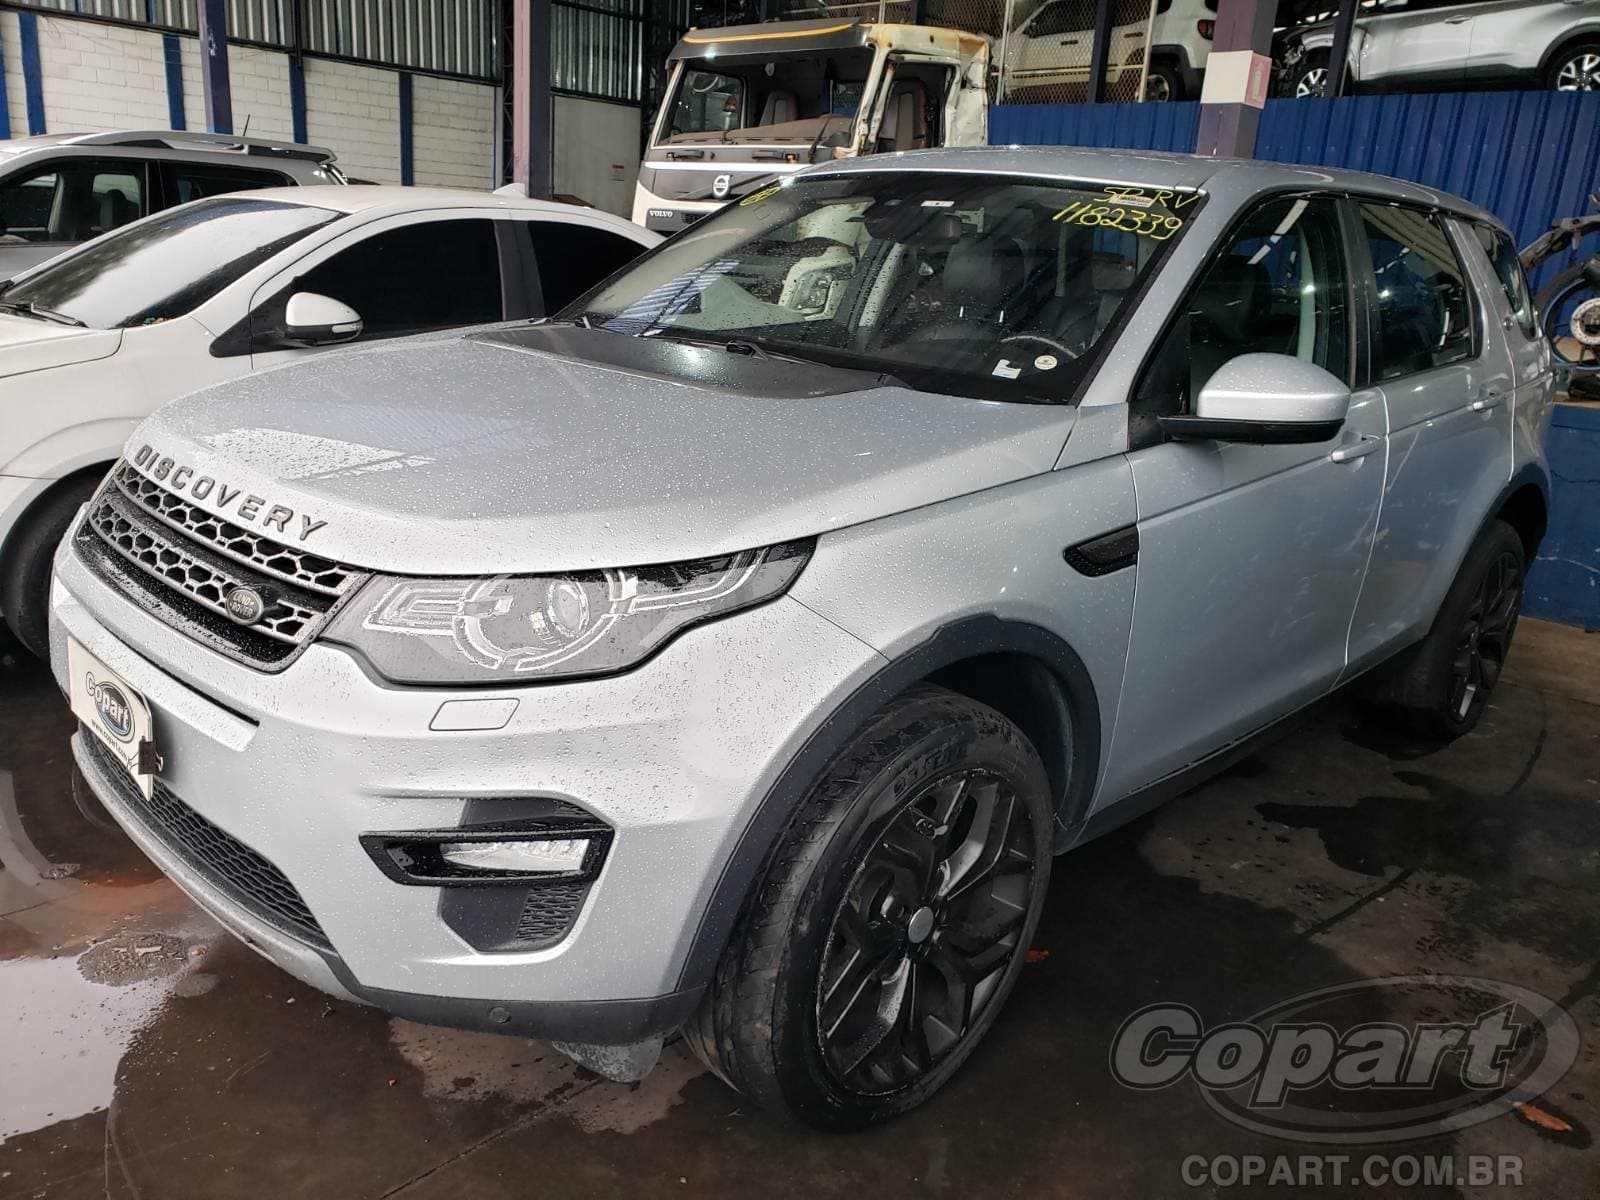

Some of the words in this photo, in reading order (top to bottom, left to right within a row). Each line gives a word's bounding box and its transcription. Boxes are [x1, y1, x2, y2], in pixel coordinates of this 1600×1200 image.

[649, 209, 674, 219] VOLVO
[1052, 201, 1183, 240] 1182339
[133, 443, 329, 542] DISCOVERY
[85, 671, 130, 733] Copart
